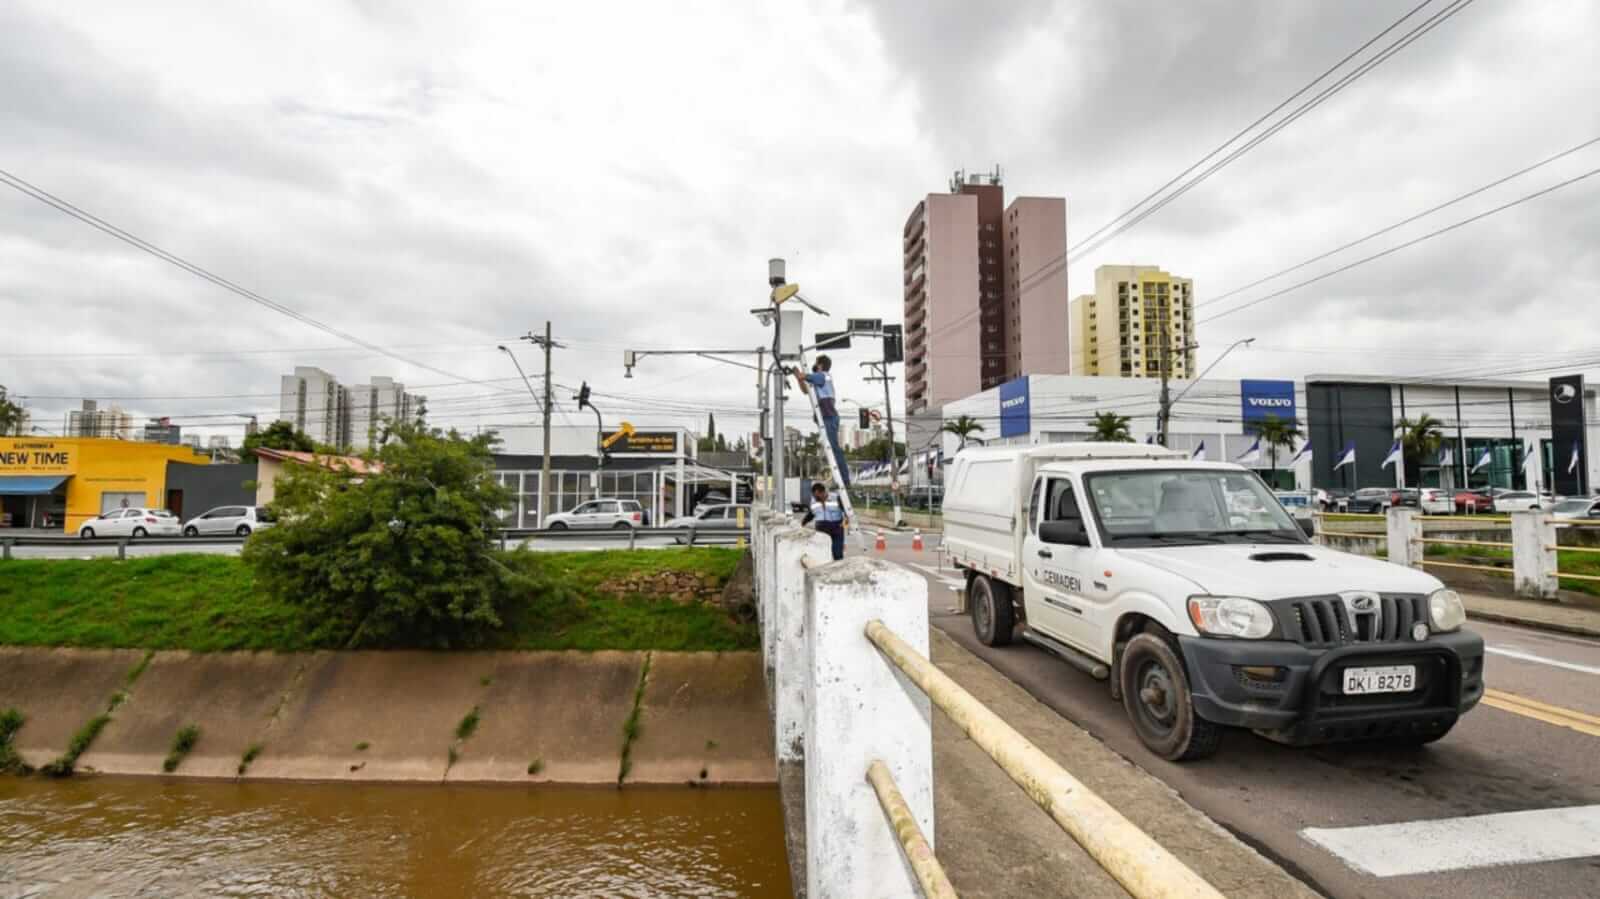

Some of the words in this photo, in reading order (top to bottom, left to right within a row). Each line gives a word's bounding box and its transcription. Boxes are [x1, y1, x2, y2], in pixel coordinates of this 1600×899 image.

[1248, 397, 1292, 407] VOLVO
[0, 451, 30, 465] NEW
[34, 451, 69, 465] TIME
[1378, 674, 1412, 689] 8278
